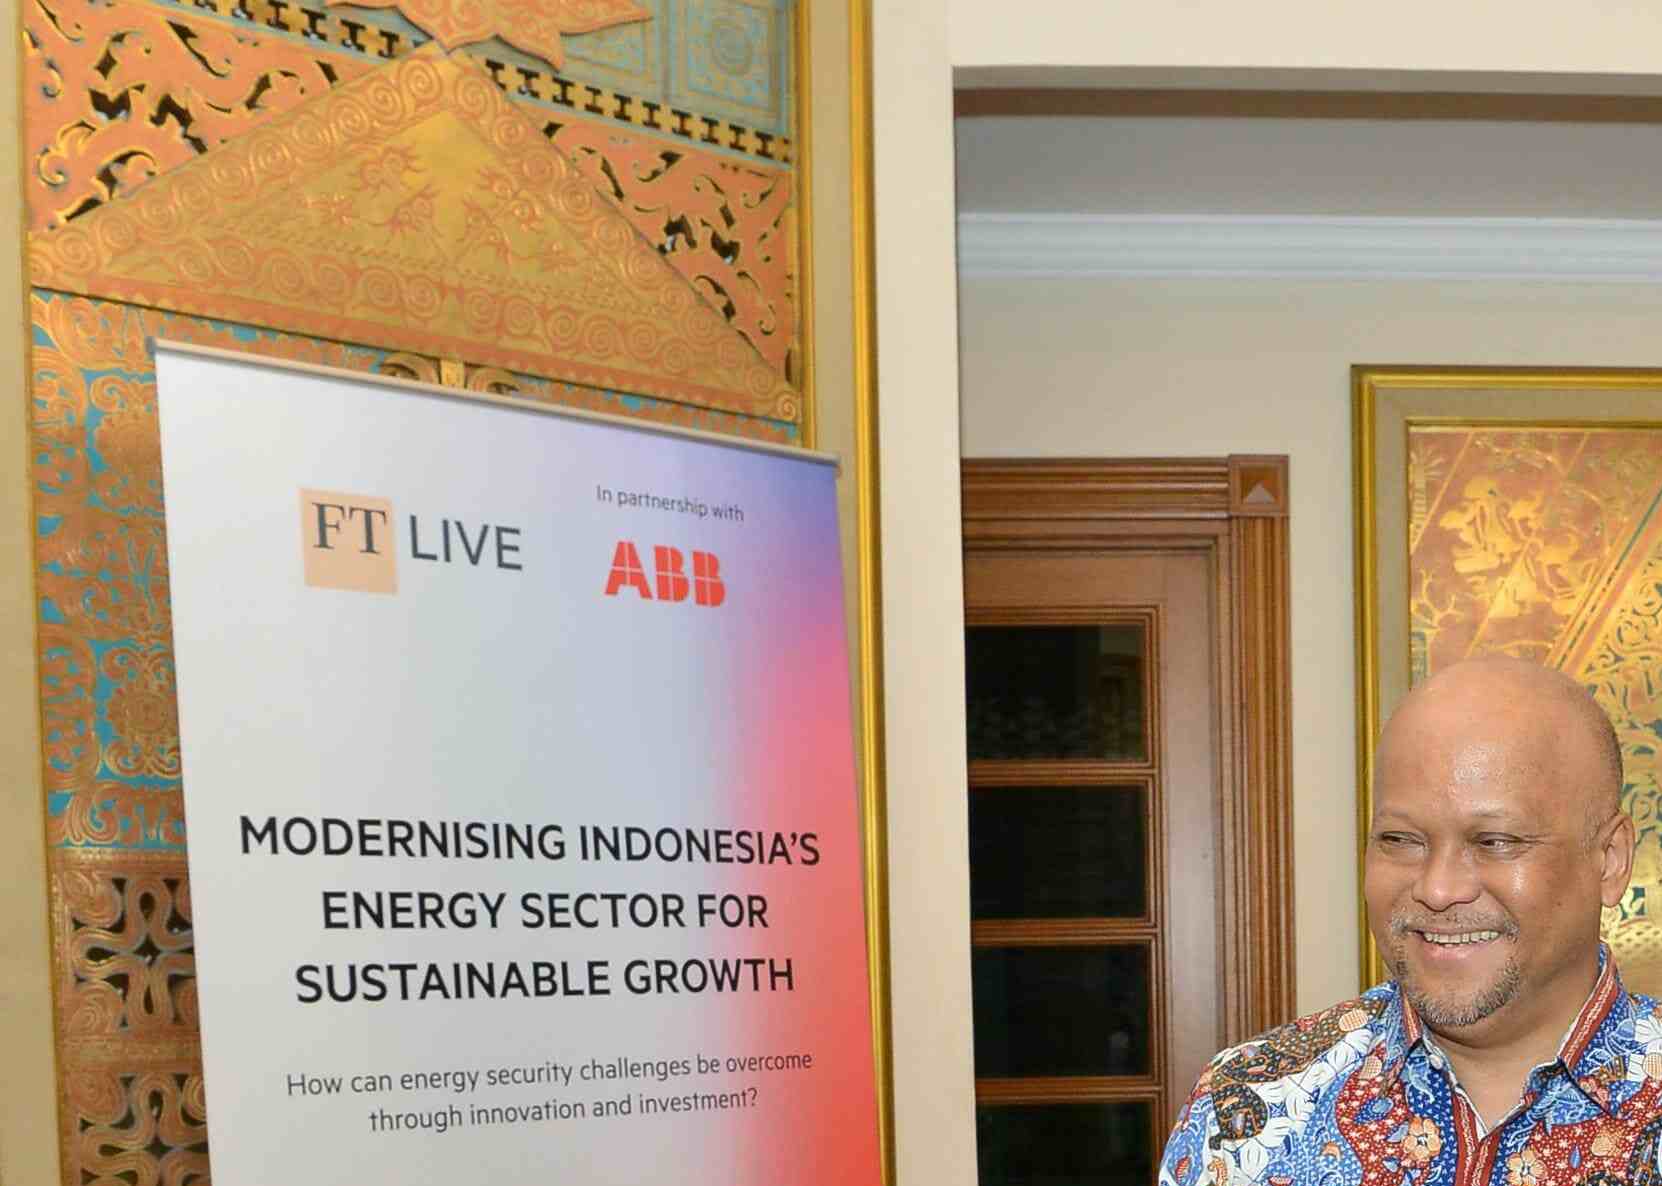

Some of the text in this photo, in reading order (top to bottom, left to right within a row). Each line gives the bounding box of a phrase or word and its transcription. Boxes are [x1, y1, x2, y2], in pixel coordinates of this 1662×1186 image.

[597, 485, 745, 523] In partnership with
[311, 502, 523, 571] FT LIVE
[604, 540, 726, 608] ABB
[239, 815, 567, 860] MODERNISING
[321, 891, 769, 930] ENERGY SECTOR FOR
[296, 957, 796, 1003] SUSTAINABLE GROWTH
[287, 1053, 813, 1096] How can energy security challenges be overcome
[368, 1087, 759, 1134] through innovation and investment?
